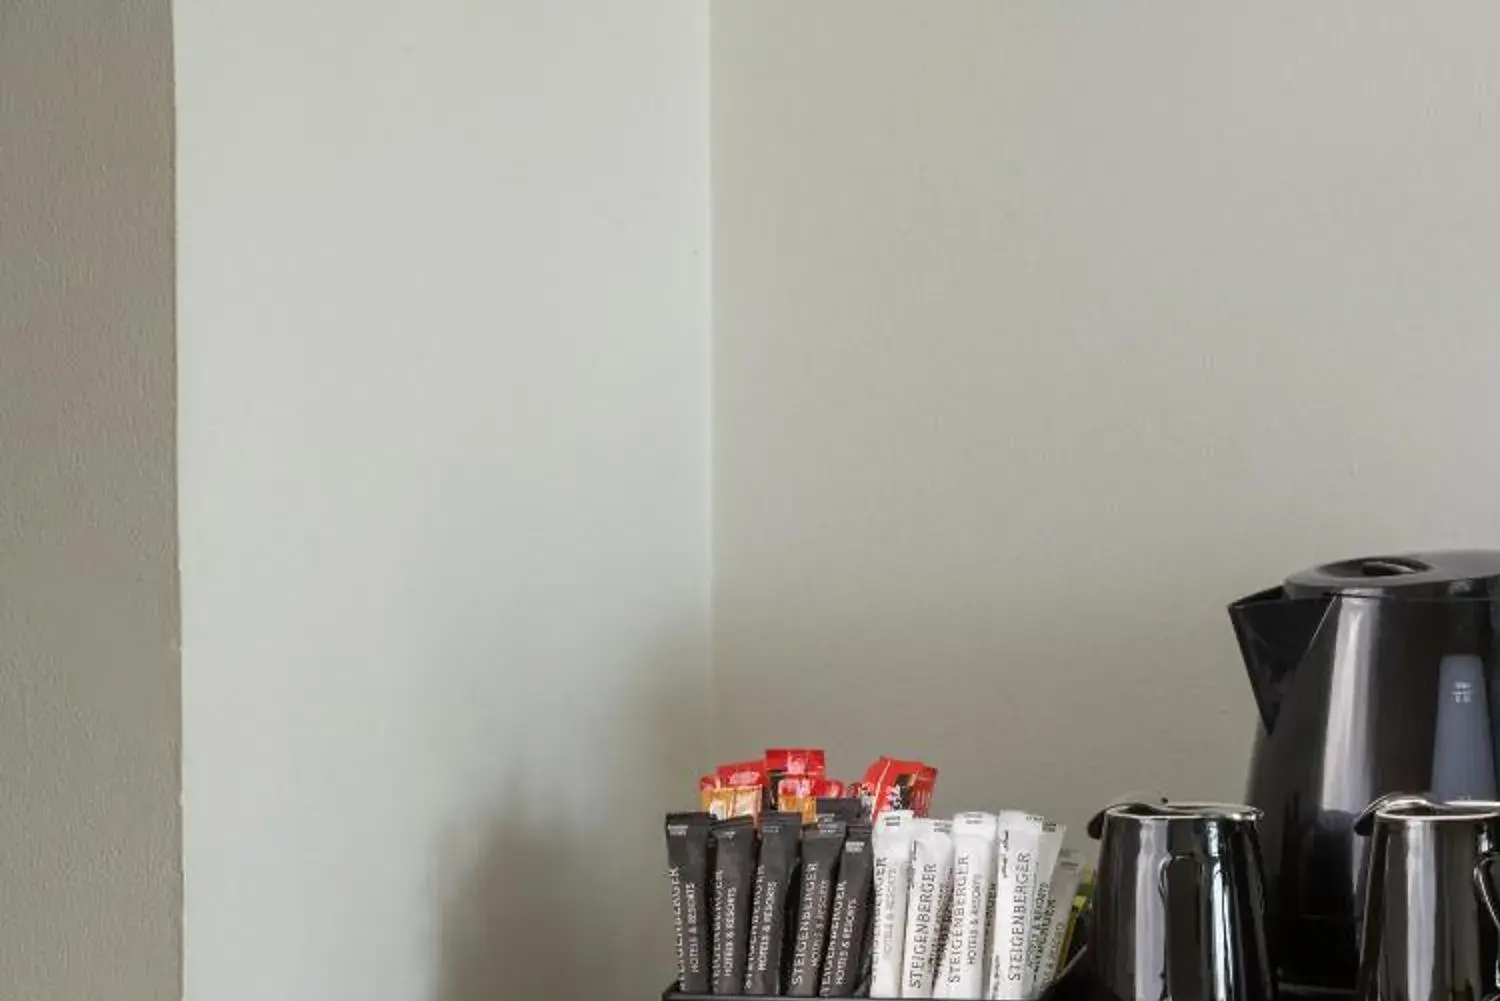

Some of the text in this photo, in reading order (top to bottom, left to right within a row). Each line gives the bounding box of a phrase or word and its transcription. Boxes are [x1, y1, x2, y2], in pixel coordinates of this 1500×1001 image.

[791, 863, 818, 986] STEIGENBERGER
[909, 863, 937, 989] STEIGENBERGER
[949, 855, 969, 983] STEIGENBERGER
[1008, 852, 1030, 981] STEIGENBERGER
